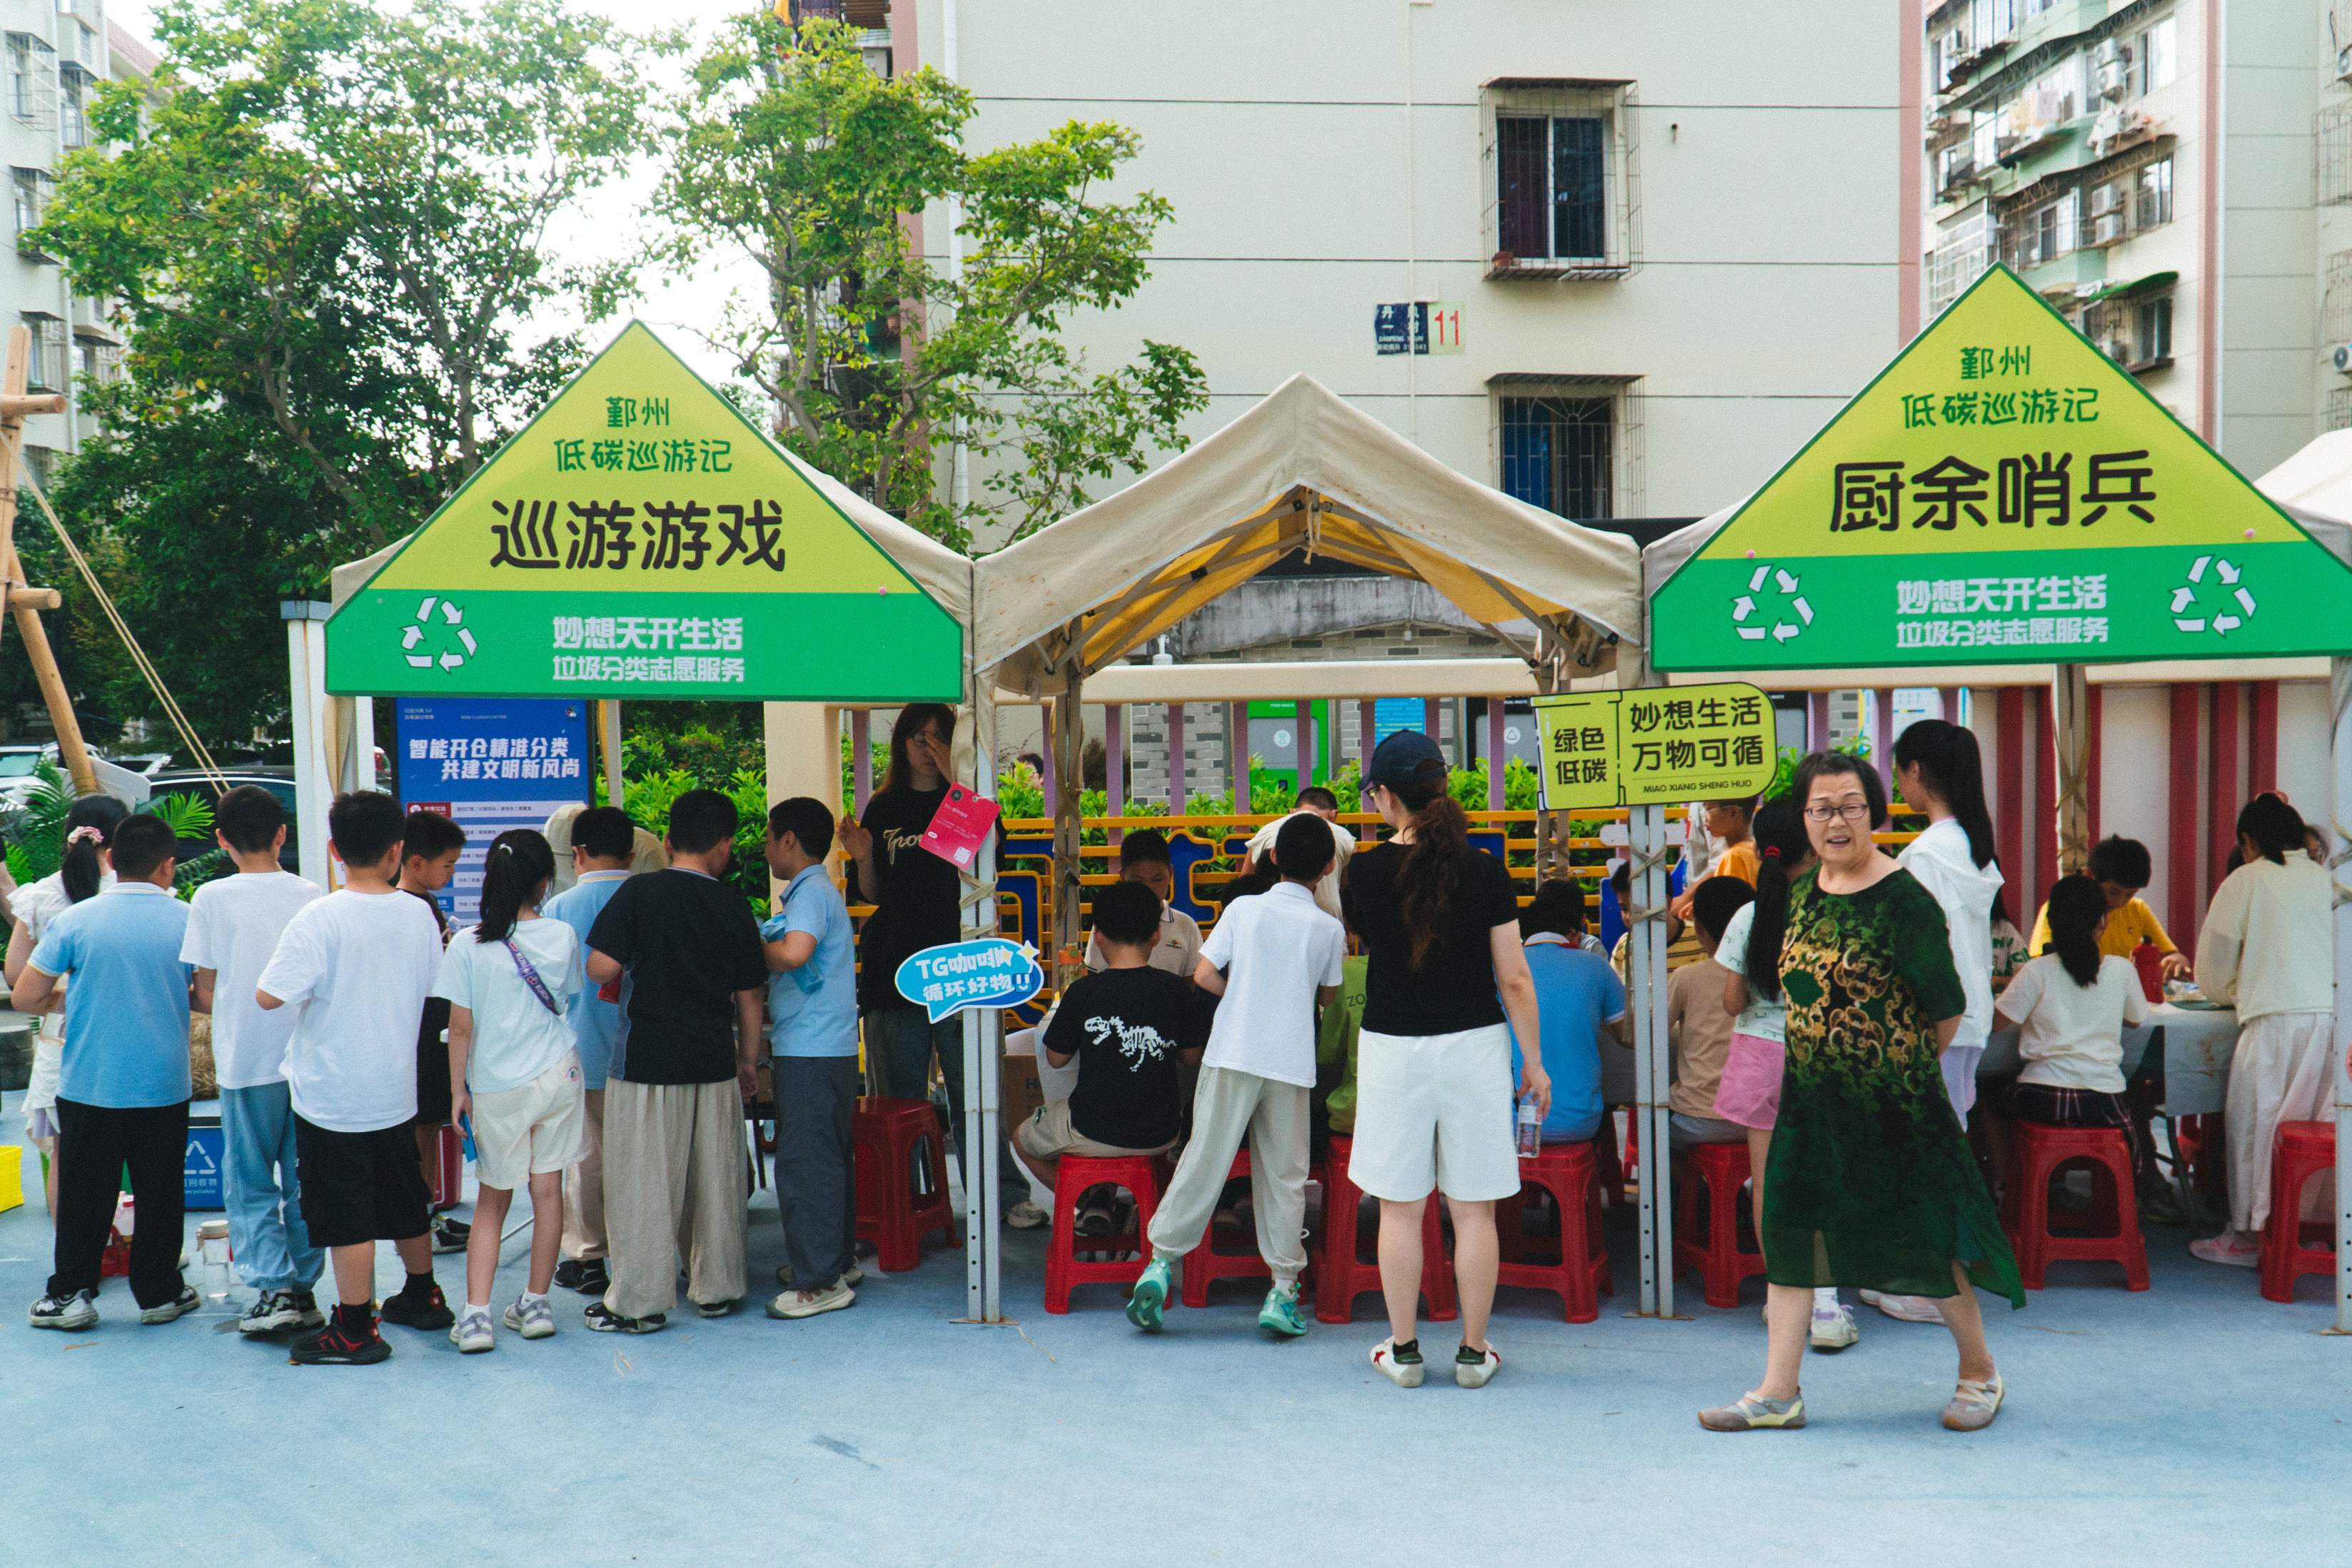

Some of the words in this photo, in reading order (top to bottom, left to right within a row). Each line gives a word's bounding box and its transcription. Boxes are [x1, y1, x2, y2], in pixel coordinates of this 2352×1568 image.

[1435, 310, 1460, 346] 11
[1959, 345, 2031, 381] 鄞州
[605, 395, 670, 428] 鄞州
[1900, 387, 2099, 430] 低碳巡游记
[552, 437, 733, 474] 低碳巡游记
[1829, 450, 2157, 533] 厨余哨兵
[490, 499, 786, 572] 巡游游戏
[1896, 573, 2107, 614] 妙想天开生活
[552, 616, 744, 651] 妙想天开生活
[1896, 616, 2109, 648] 垃圾分类志愿服务
[552, 655, 745, 683] 垃圾分类志愿服务
[1630, 695, 1762, 734] 妙想生活
[409, 737, 570, 759] 智能开仓精准分类
[1553, 726, 1606, 754] 绿色
[1631, 734, 1764, 773] 万物可循
[441, 758, 580, 780] 共建文明新风尚
[1555, 757, 1607, 786] 低碳
[1643, 784, 1667, 794] MIAO
[1669, 782, 1697, 791] XIANG
[1699, 780, 1730, 790] SHENG
[1731, 779, 1752, 789] HUO
[915, 946, 1006, 980] TG咖啡
[922, 972, 1013, 1003] 循环好物
[184, 1178, 217, 1187] 回收物
